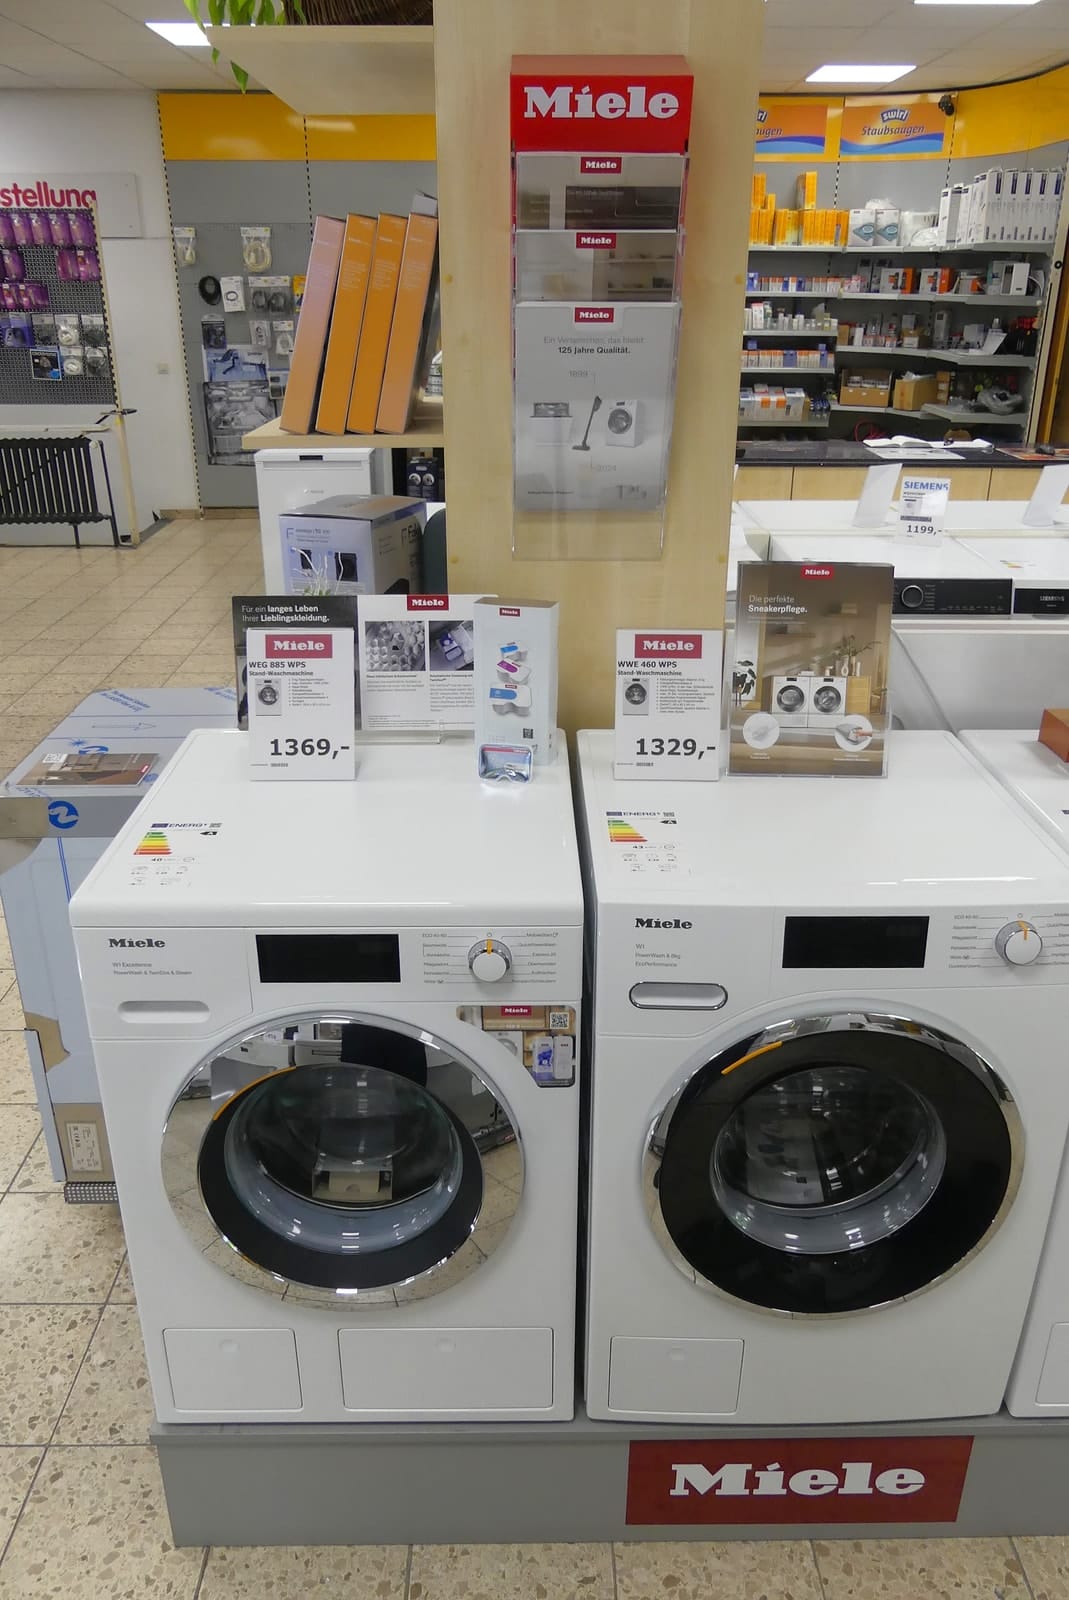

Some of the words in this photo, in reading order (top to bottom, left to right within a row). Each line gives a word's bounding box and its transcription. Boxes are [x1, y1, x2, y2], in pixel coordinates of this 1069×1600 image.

[524, 86, 679, 119] Miele
[882, 109, 908, 121] swirl
[862, 125, 925, 136] Staubsaugen
[585, 161, 617, 169] Miele
[581, 237, 612, 245] Miele
[558, 346, 572, 354] 125
[573, 346, 595, 355] Jahre
[906, 525, 943, 536] 1199,-
[411, 599, 445, 607] Miele
[748, 595, 763, 603] Die
[763, 595, 795, 605] perfekte
[267, 605, 294, 614] langes
[748, 604, 808, 614] Sneakerpflege.
[260, 615, 330, 623] Lieblingskleidung.
[273, 640, 326, 651] Miele
[642, 640, 695, 651] Miele
[249, 661, 268, 669] WEG
[269, 661, 286, 669] 885
[287, 661, 306, 669] WPS
[270, 738, 350, 760] 1369,-
[636, 738, 716, 760] 1329,-
[634, 917, 693, 930] Miele
[108, 938, 166, 948] Miele
[669, 1461, 927, 1496] Miele
